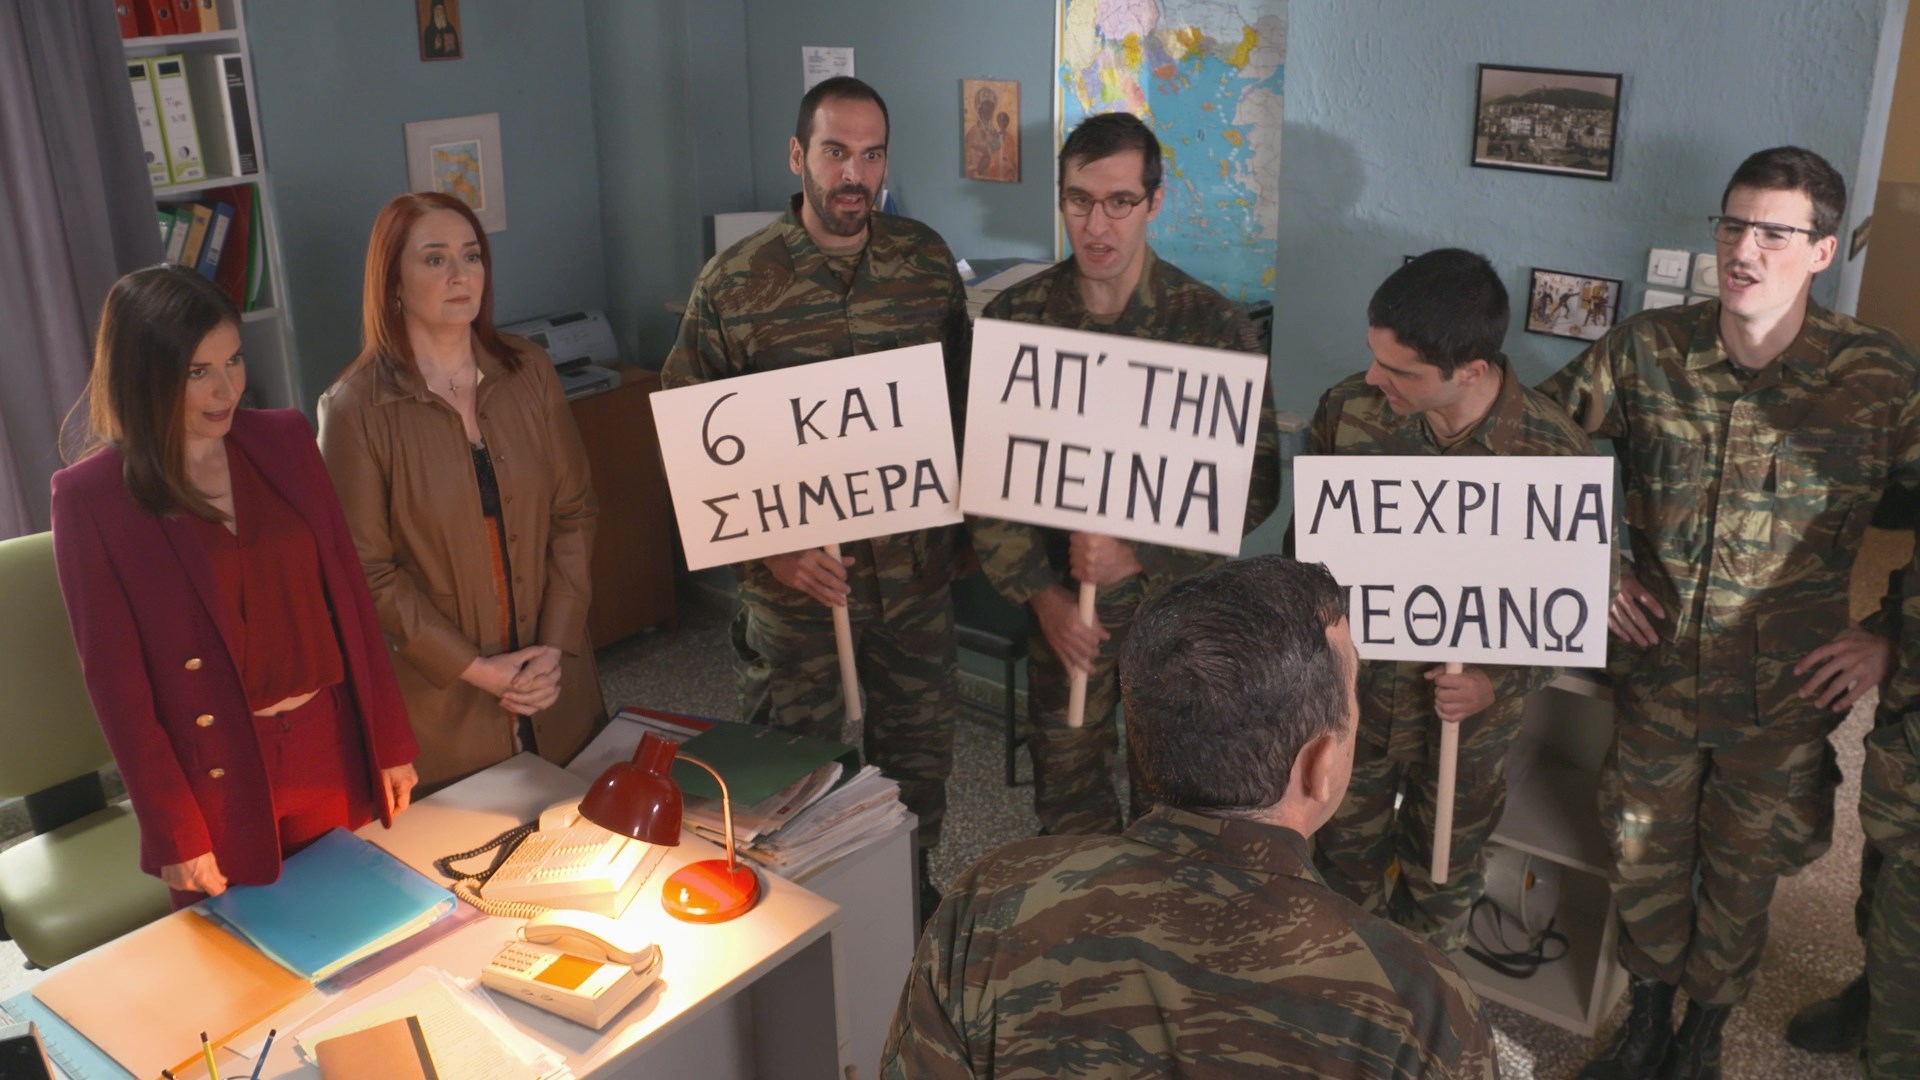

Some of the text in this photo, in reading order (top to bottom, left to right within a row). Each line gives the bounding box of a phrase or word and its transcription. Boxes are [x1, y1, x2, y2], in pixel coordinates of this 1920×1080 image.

[702, 381, 904, 466] 6 ΚΑΙ
[1128, 361, 1254, 446] ΤΗΝ
[702, 458, 950, 543] ΣΗΜΕΡΑ
[1001, 435, 1221, 535] ΠΕΙΝΑ
[1309, 479, 1609, 544] ΜΕΧΡΙ ΝΑ
